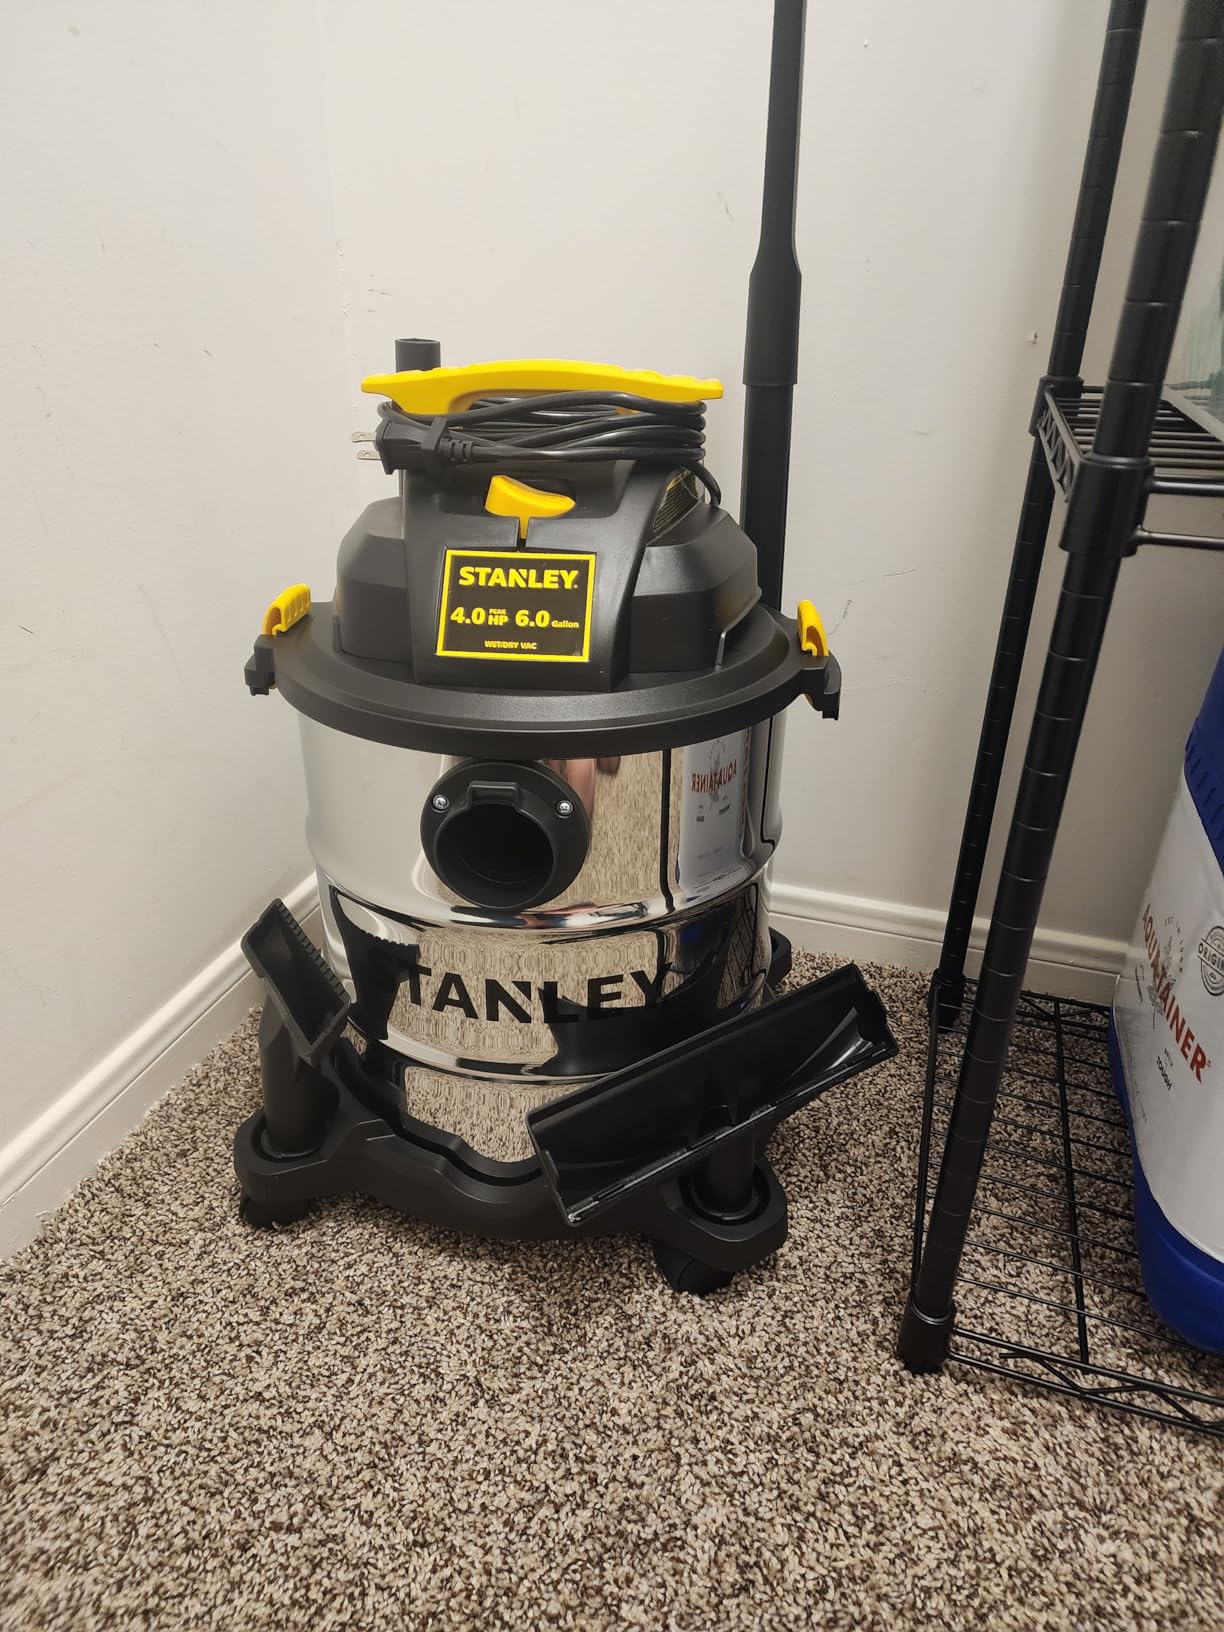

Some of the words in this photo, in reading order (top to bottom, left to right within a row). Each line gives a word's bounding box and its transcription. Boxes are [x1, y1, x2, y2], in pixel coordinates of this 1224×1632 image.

[459, 566, 577, 590] STANLEY
[450, 607, 486, 626] 4.0
[489, 608, 507, 616] PEAK
[488, 615, 509, 626] HP
[515, 609, 551, 628] 6.0
[551, 620, 580, 629] Gallon
[520, 642, 537, 650] VAC
